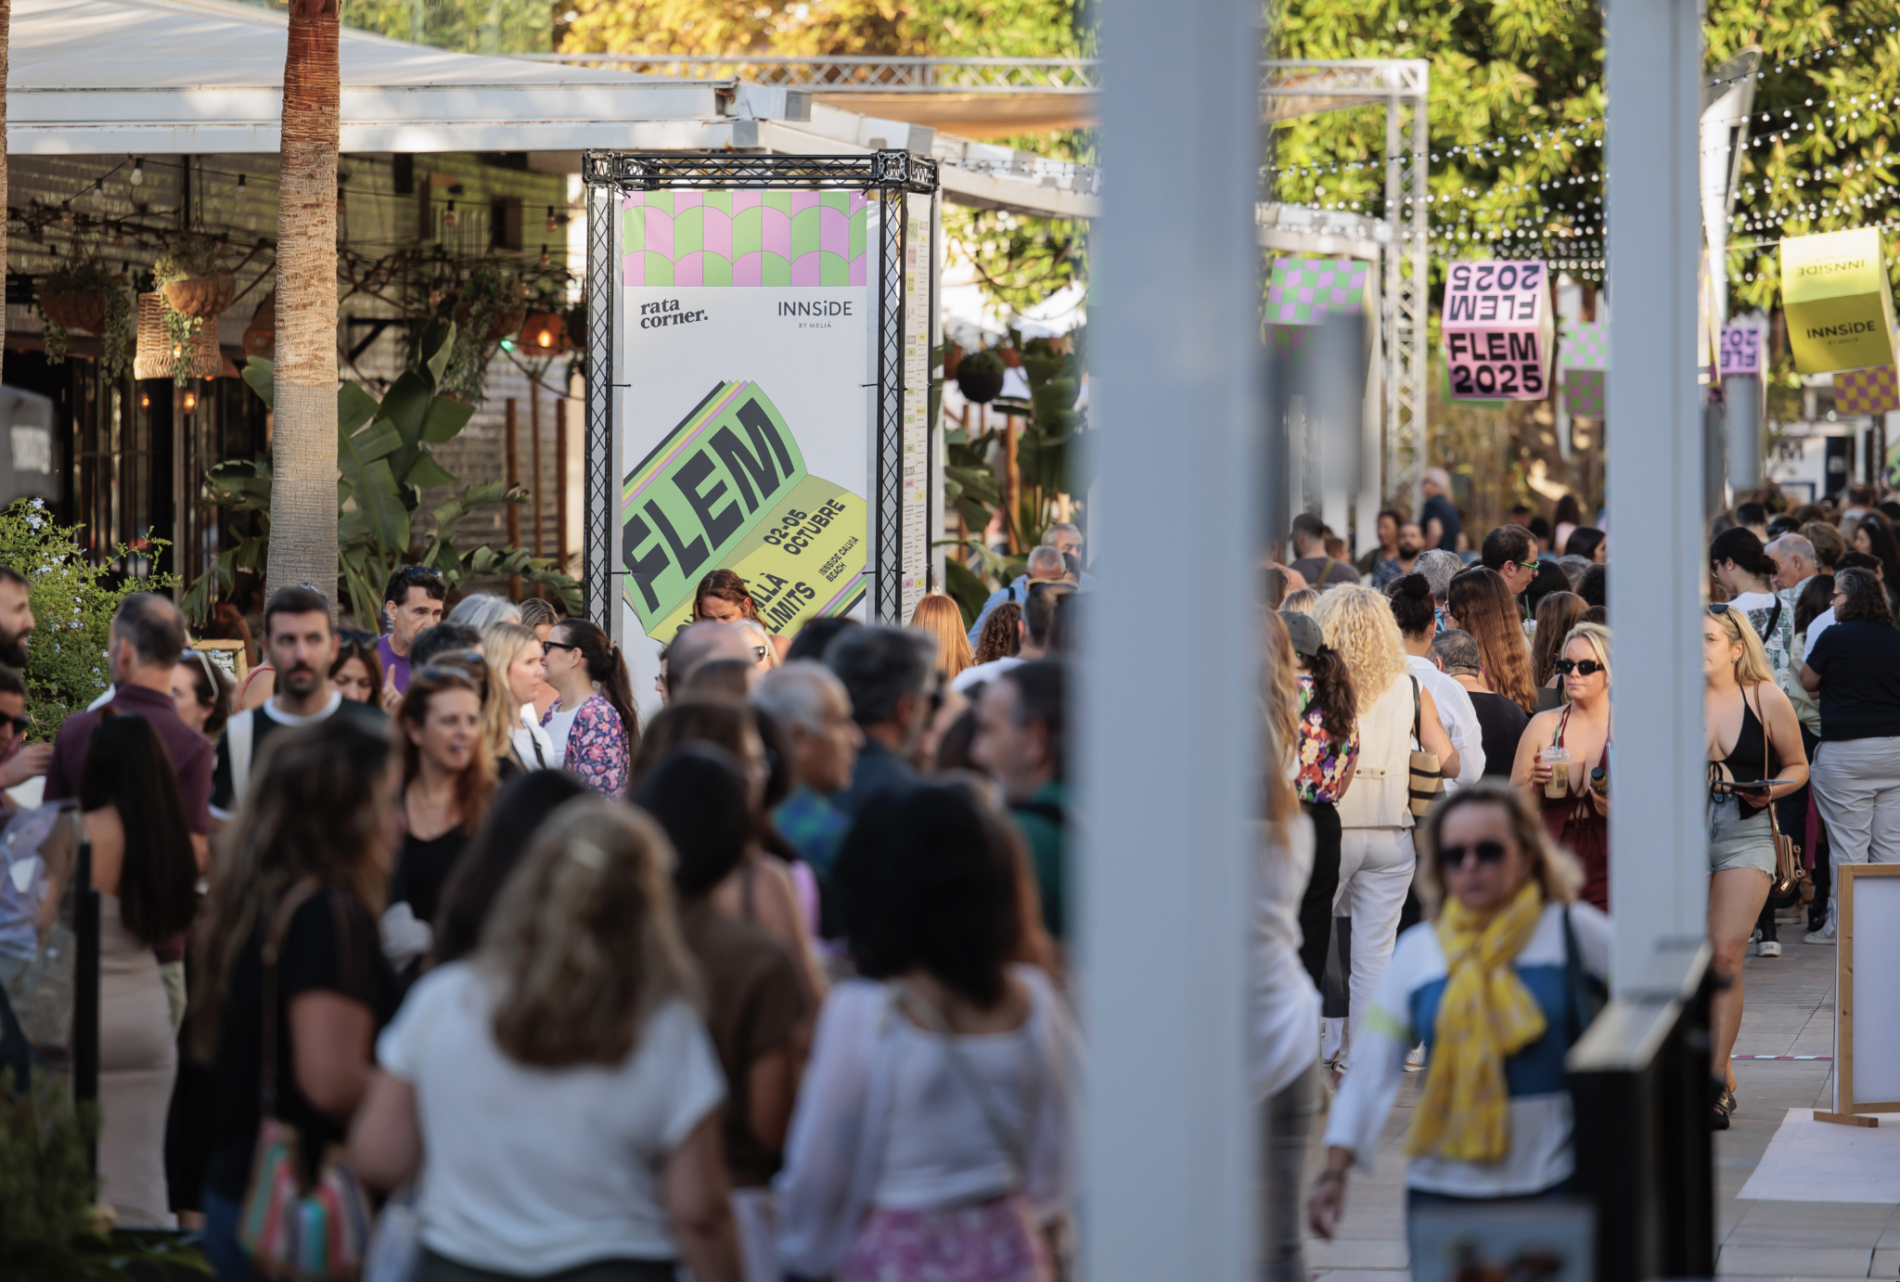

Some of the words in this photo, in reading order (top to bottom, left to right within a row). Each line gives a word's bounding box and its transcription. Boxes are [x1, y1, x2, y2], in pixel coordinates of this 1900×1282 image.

[1452, 265, 1540, 291] 2025
[640, 298, 680, 316] rata
[640, 309, 708, 329] corner.
[1449, 294, 1537, 321] FLEM
[1448, 332, 1538, 361] FLEM
[1720, 350, 1757, 367] FLE
[1453, 364, 1542, 394] 2025
[622, 397, 795, 614] FLEM
[763, 508, 808, 546] 02-05
[783, 498, 846, 556] OCTUBRE
[825, 561, 847, 583] BEACH
[752, 572, 789, 608] LLÀ
[762, 581, 816, 634] LÍMITS
